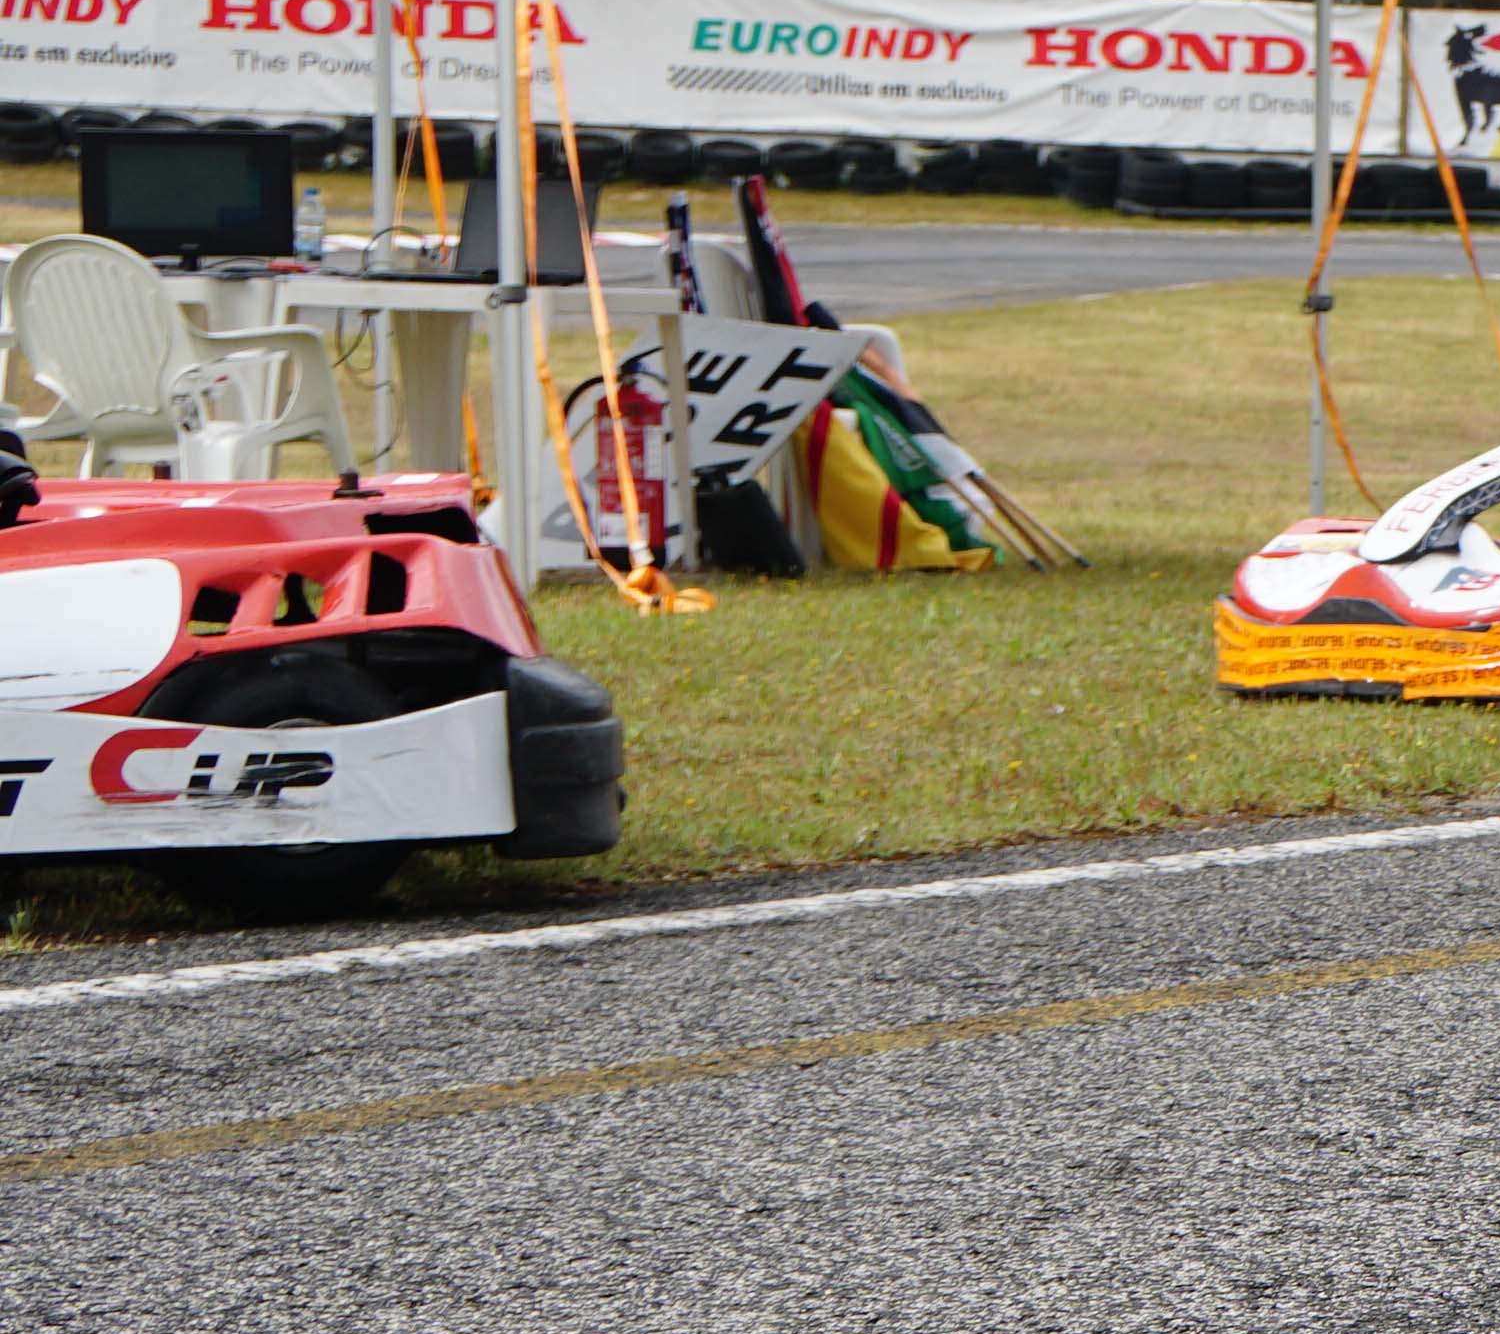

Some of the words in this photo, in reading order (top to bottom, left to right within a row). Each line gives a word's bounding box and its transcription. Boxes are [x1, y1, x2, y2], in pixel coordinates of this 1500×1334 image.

[690, 18, 976, 64] EUROINDY
[1024, 25, 1370, 82] HONDA
[233, 47, 288, 74] The
[298, 51, 377, 75] Powe
[440, 55, 556, 86] Dreas
[1059, 84, 1109, 108] The
[1121, 87, 1206, 111] Power
[1216, 89, 1242, 113] of
